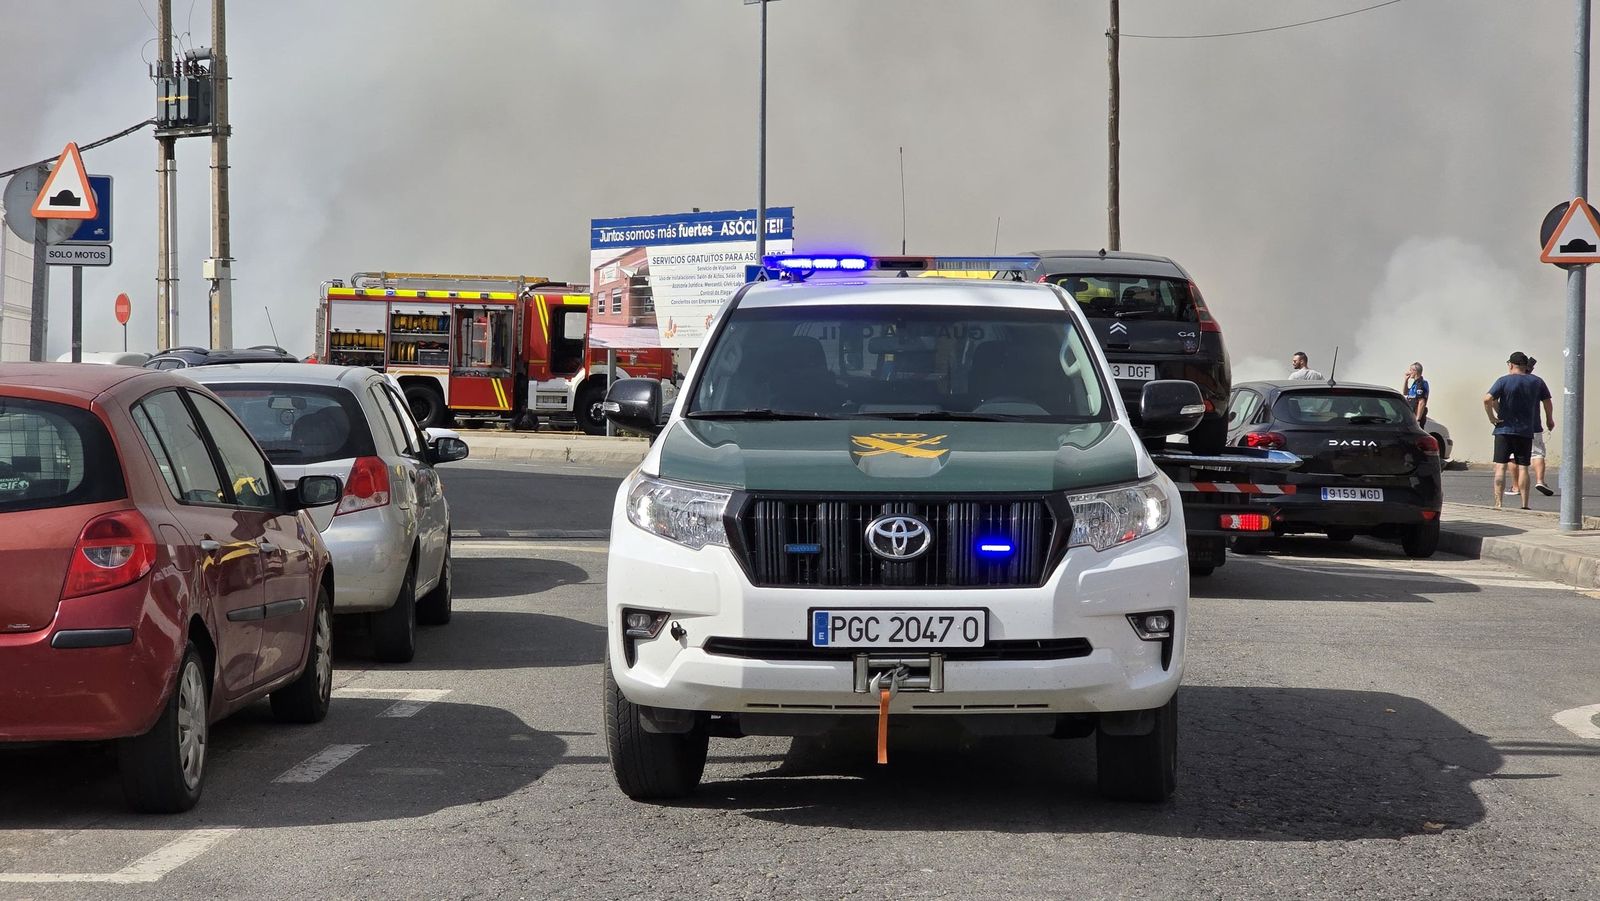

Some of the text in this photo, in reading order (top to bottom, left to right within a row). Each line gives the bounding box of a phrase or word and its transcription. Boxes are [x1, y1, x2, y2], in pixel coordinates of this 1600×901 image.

[600, 216, 784, 243] Juntos somos más fuertes ASÓCITE!!
[49, 251, 106, 259] SOLO MOTOS
[652, 255, 686, 265] SERVICIOS
[686, 253, 724, 264] GRATUITOS
[724, 252, 743, 262] PARA
[1127, 365, 1152, 378] DGF
[1328, 488, 1357, 499] 9159
[1360, 489, 1381, 500] MGD
[818, 632, 825, 640] E
[831, 616, 880, 643] PGC
[888, 616, 955, 643] 2047
